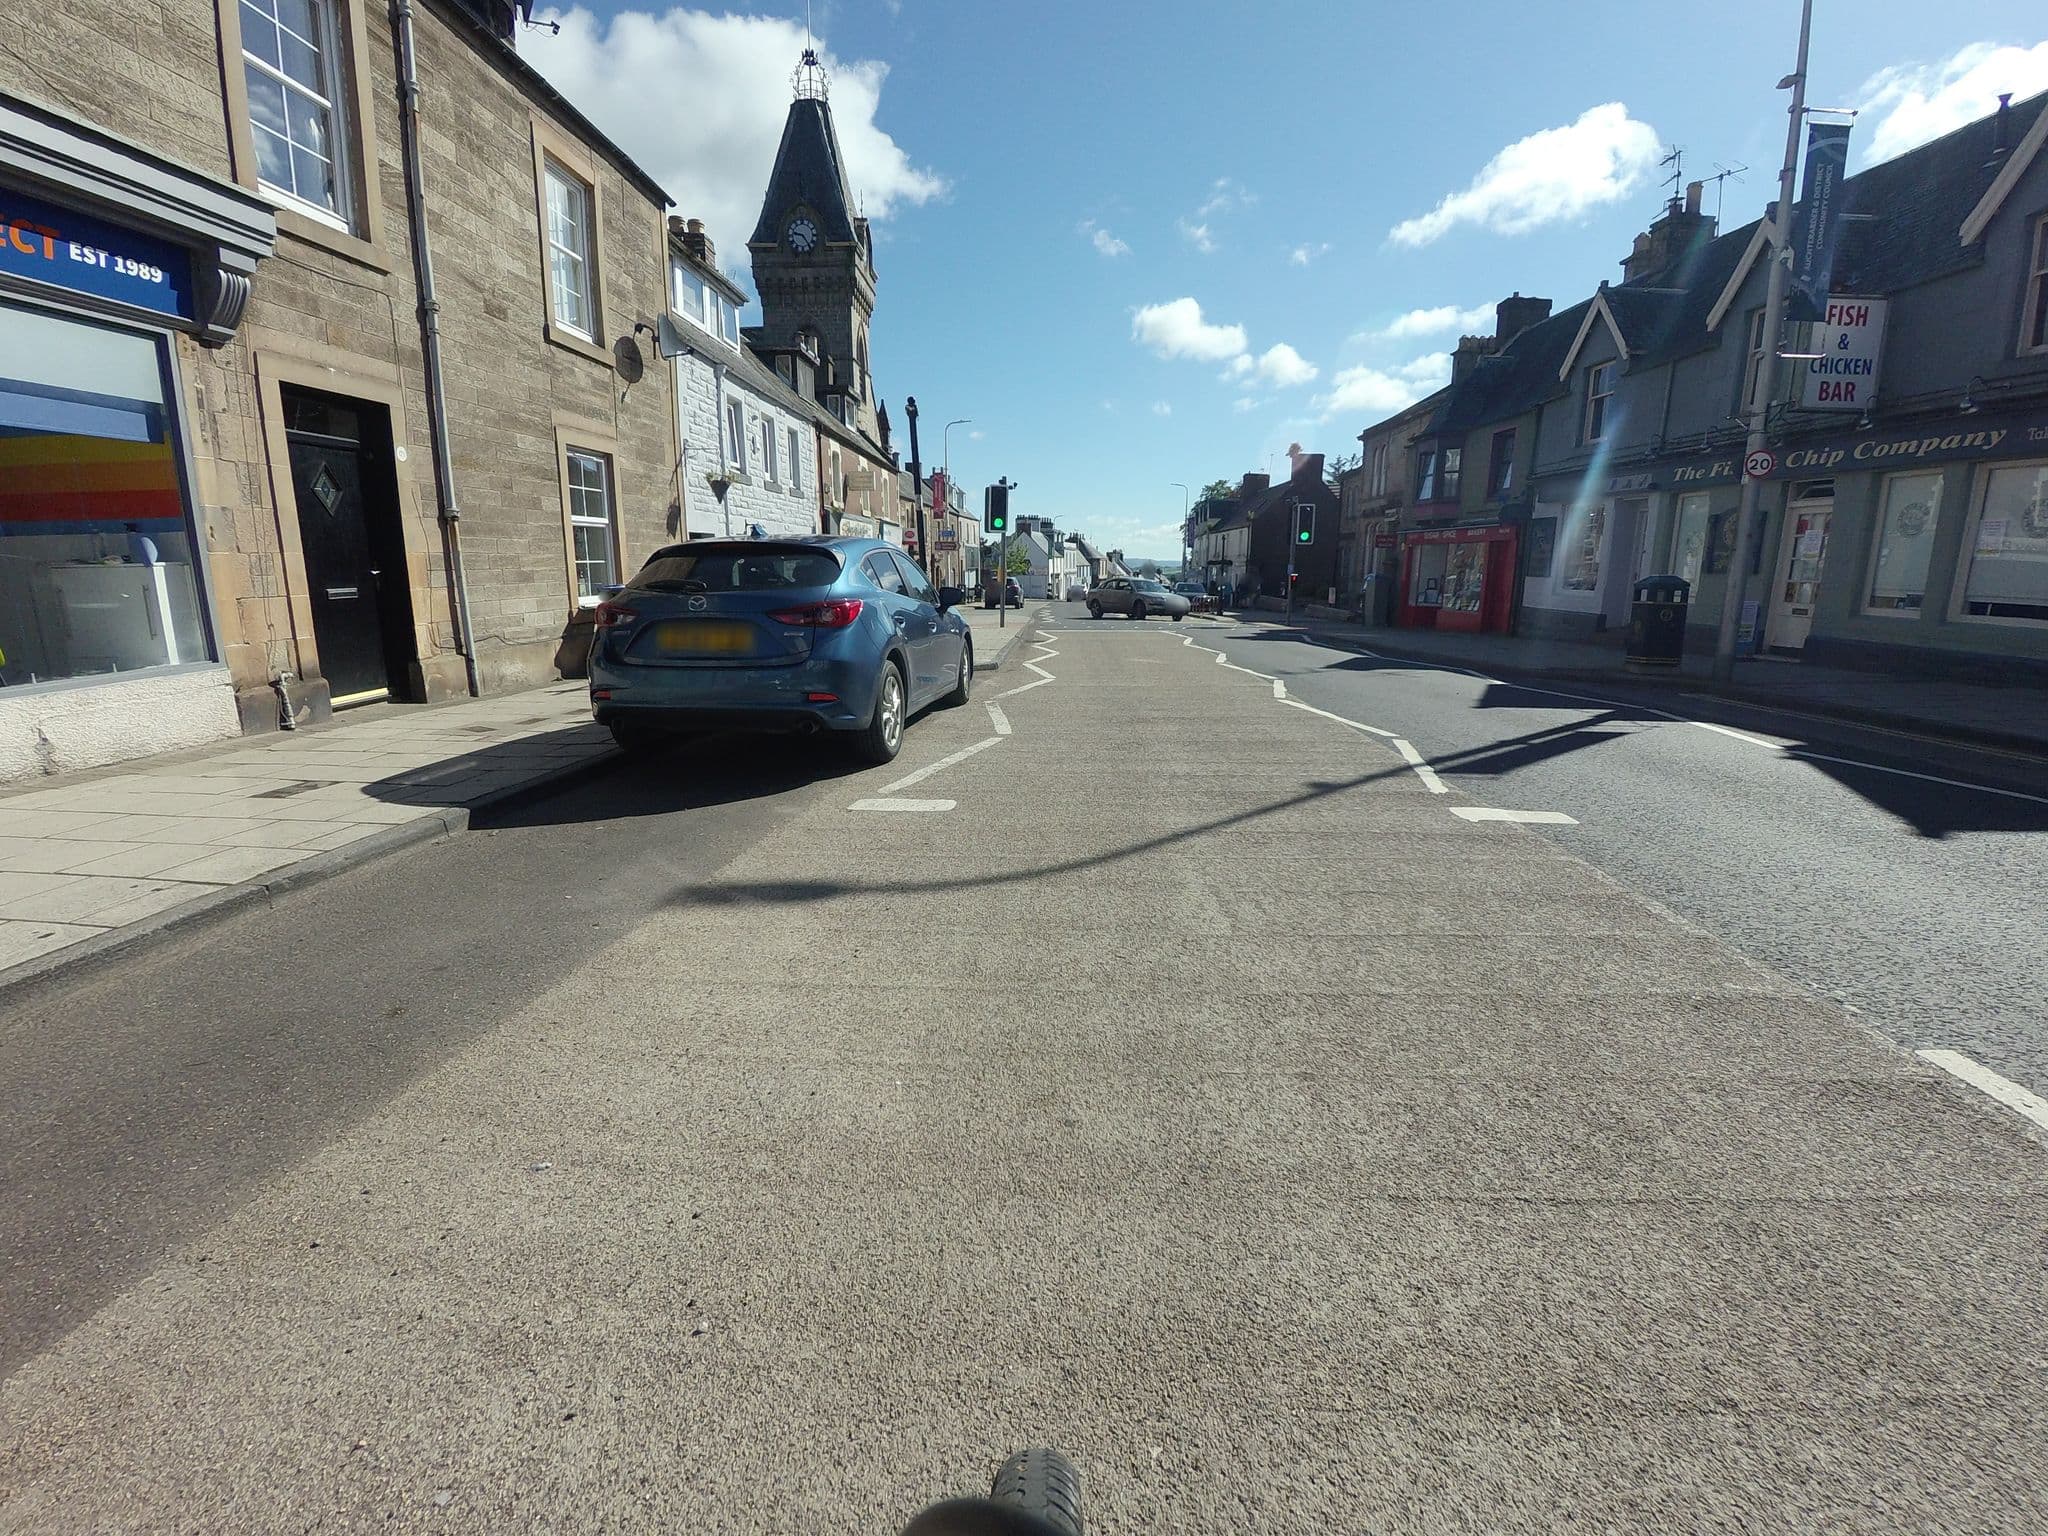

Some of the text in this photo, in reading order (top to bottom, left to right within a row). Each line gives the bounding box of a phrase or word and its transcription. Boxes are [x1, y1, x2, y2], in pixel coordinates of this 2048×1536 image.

[1817, 163, 1834, 249] COMMUNITY COUNCIL
[69, 241, 109, 268] EST
[114, 255, 163, 284] 1989
[1826, 304, 1869, 327] FISH
[1837, 333, 1850, 350] &
[1809, 358, 1873, 376] CHICKEN
[1818, 381, 1856, 402] BAR
[1673, 467, 1706, 482] The
[1785, 447, 1845, 468] Chip
[1853, 429, 2008, 460] Company
[1749, 458, 1770, 471] 20
